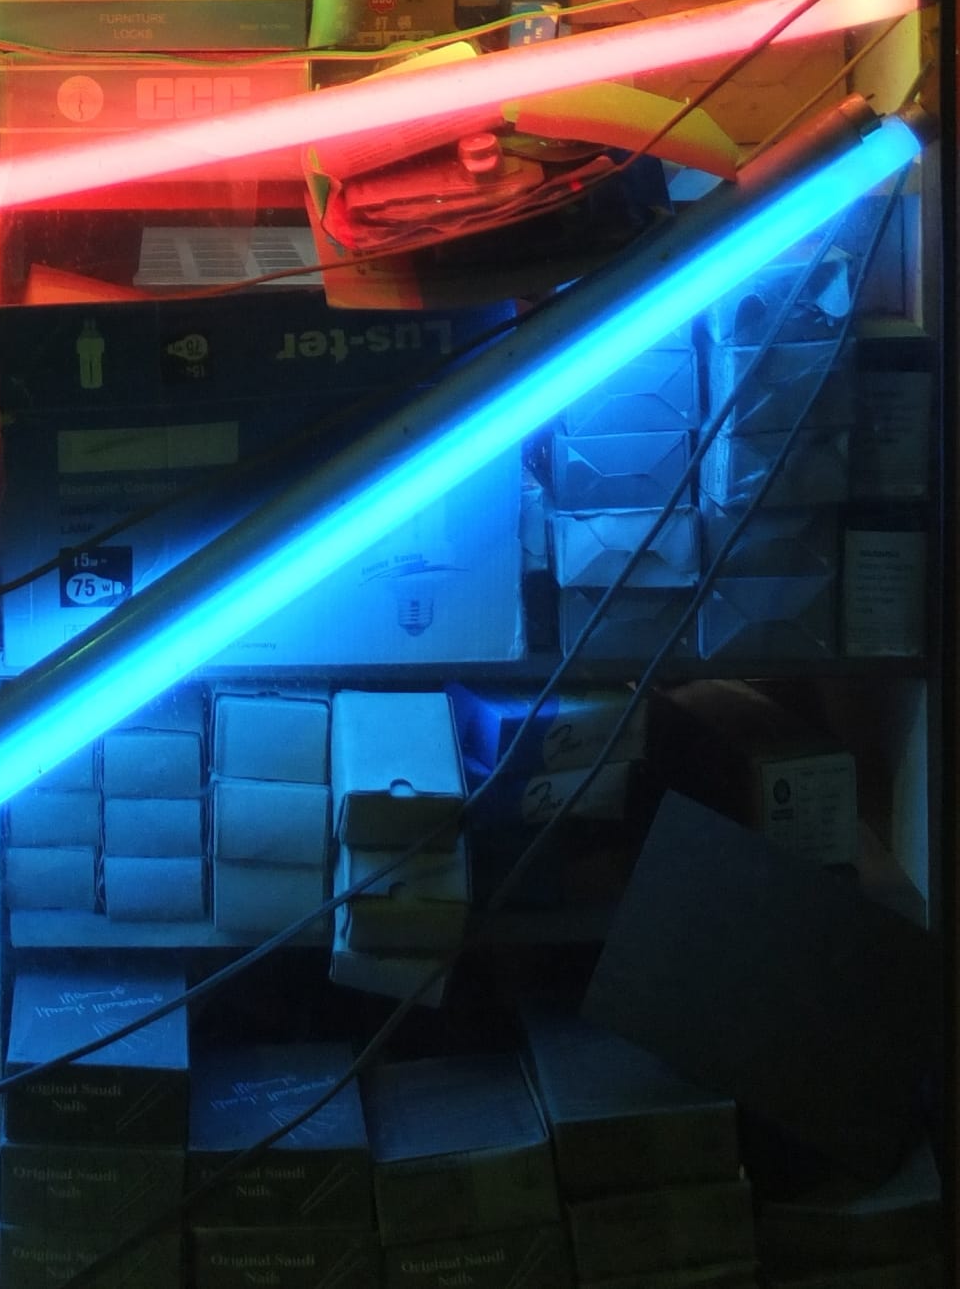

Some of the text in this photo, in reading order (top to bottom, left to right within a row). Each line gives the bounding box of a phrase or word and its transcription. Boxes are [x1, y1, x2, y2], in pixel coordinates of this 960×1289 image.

[99, 13, 167, 24] FURNITURE
[112, 29, 153, 40] LOCKS
[73, 578, 96, 598] 75
